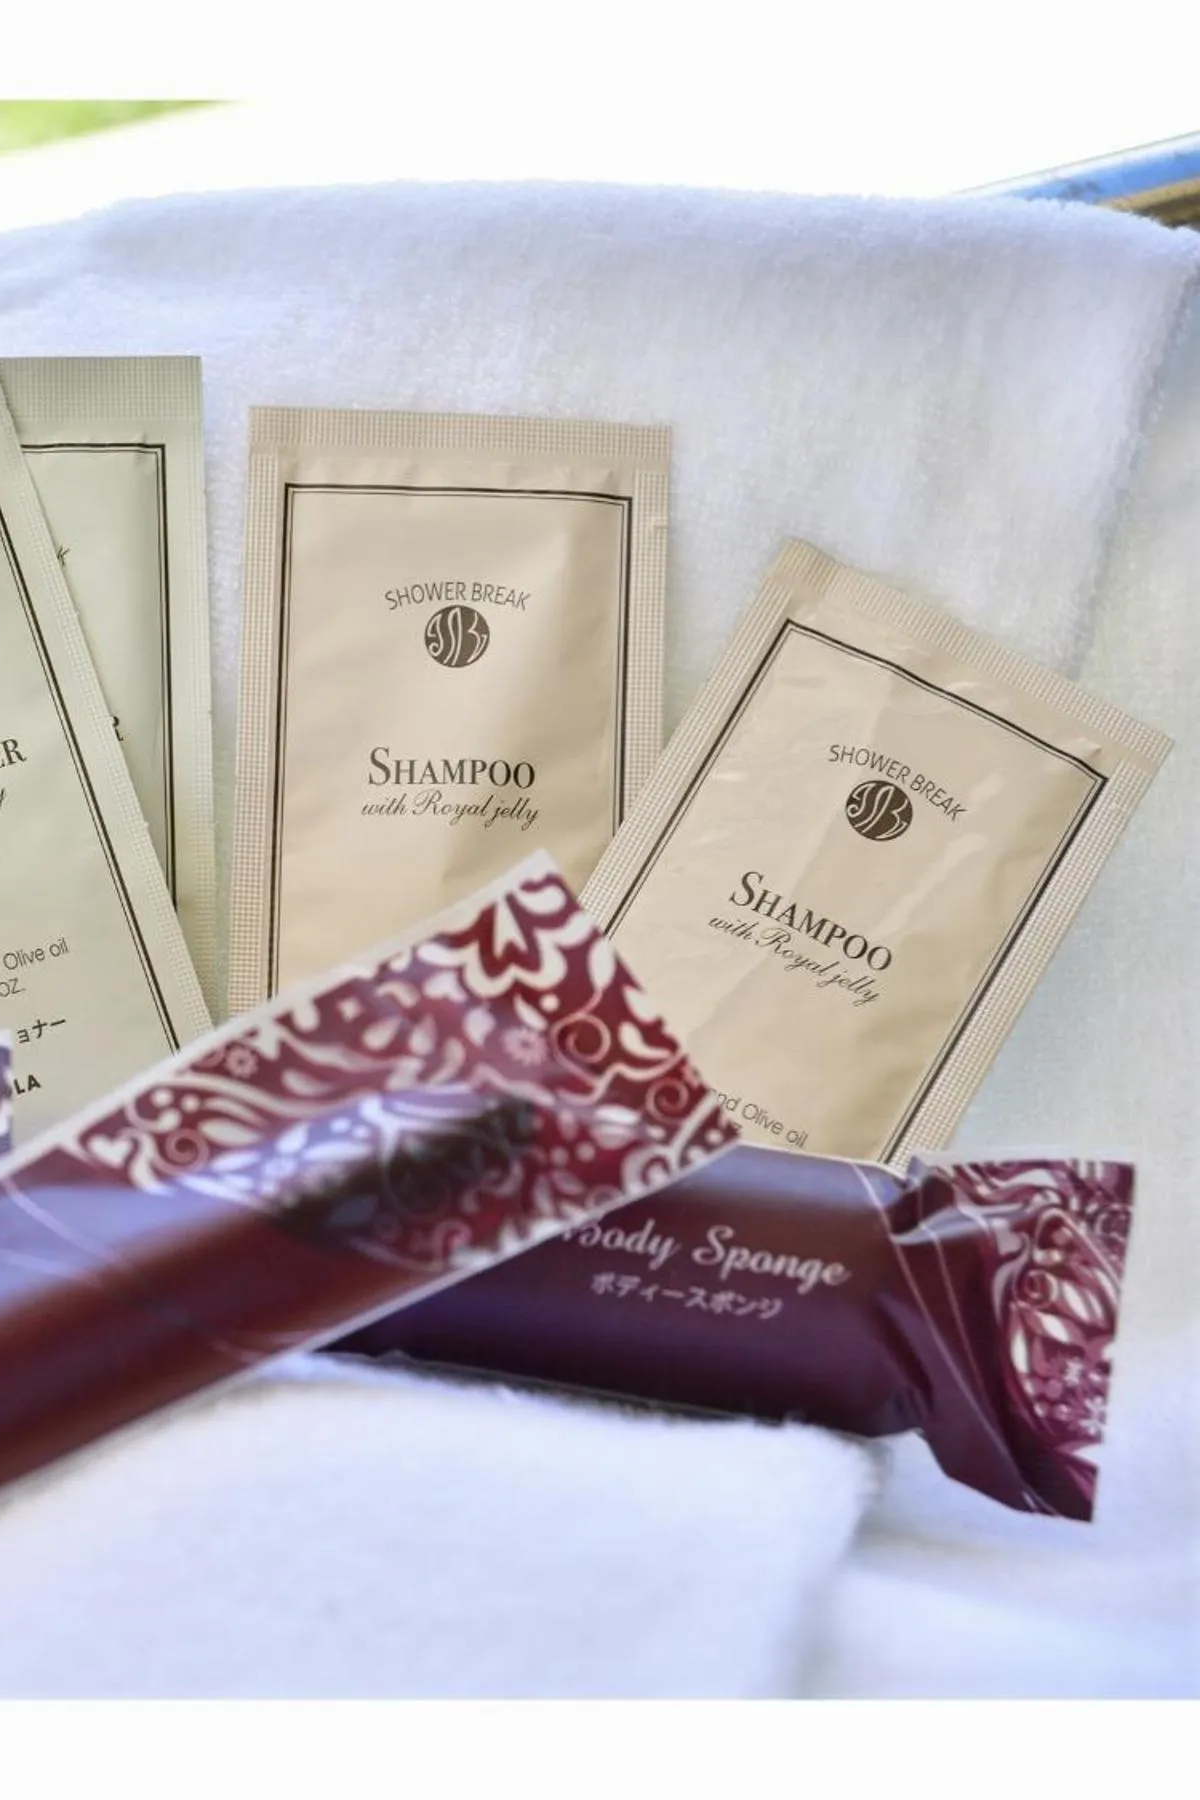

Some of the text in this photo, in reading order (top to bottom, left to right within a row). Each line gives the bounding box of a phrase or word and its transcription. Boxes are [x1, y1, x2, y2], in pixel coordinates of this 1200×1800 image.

[384, 581, 531, 611] SHOWER BREAK
[368, 746, 536, 789] SHAMPOO
[828, 744, 968, 822] SHOWER BREAK
[361, 789, 540, 831] with Royal jelly
[728, 871, 892, 971] SHAMPOO
[3, 947, 46, 970] Olive
[49, 937, 69, 957] oil
[708, 916, 880, 1007] with Royal jelly
[13, 1074, 42, 1095] LA
[711, 1089, 742, 1112] nd
[741, 1103, 784, 1135] Olive
[786, 1130, 809, 1148] oil
[691, 1225, 851, 1294] Sponge
